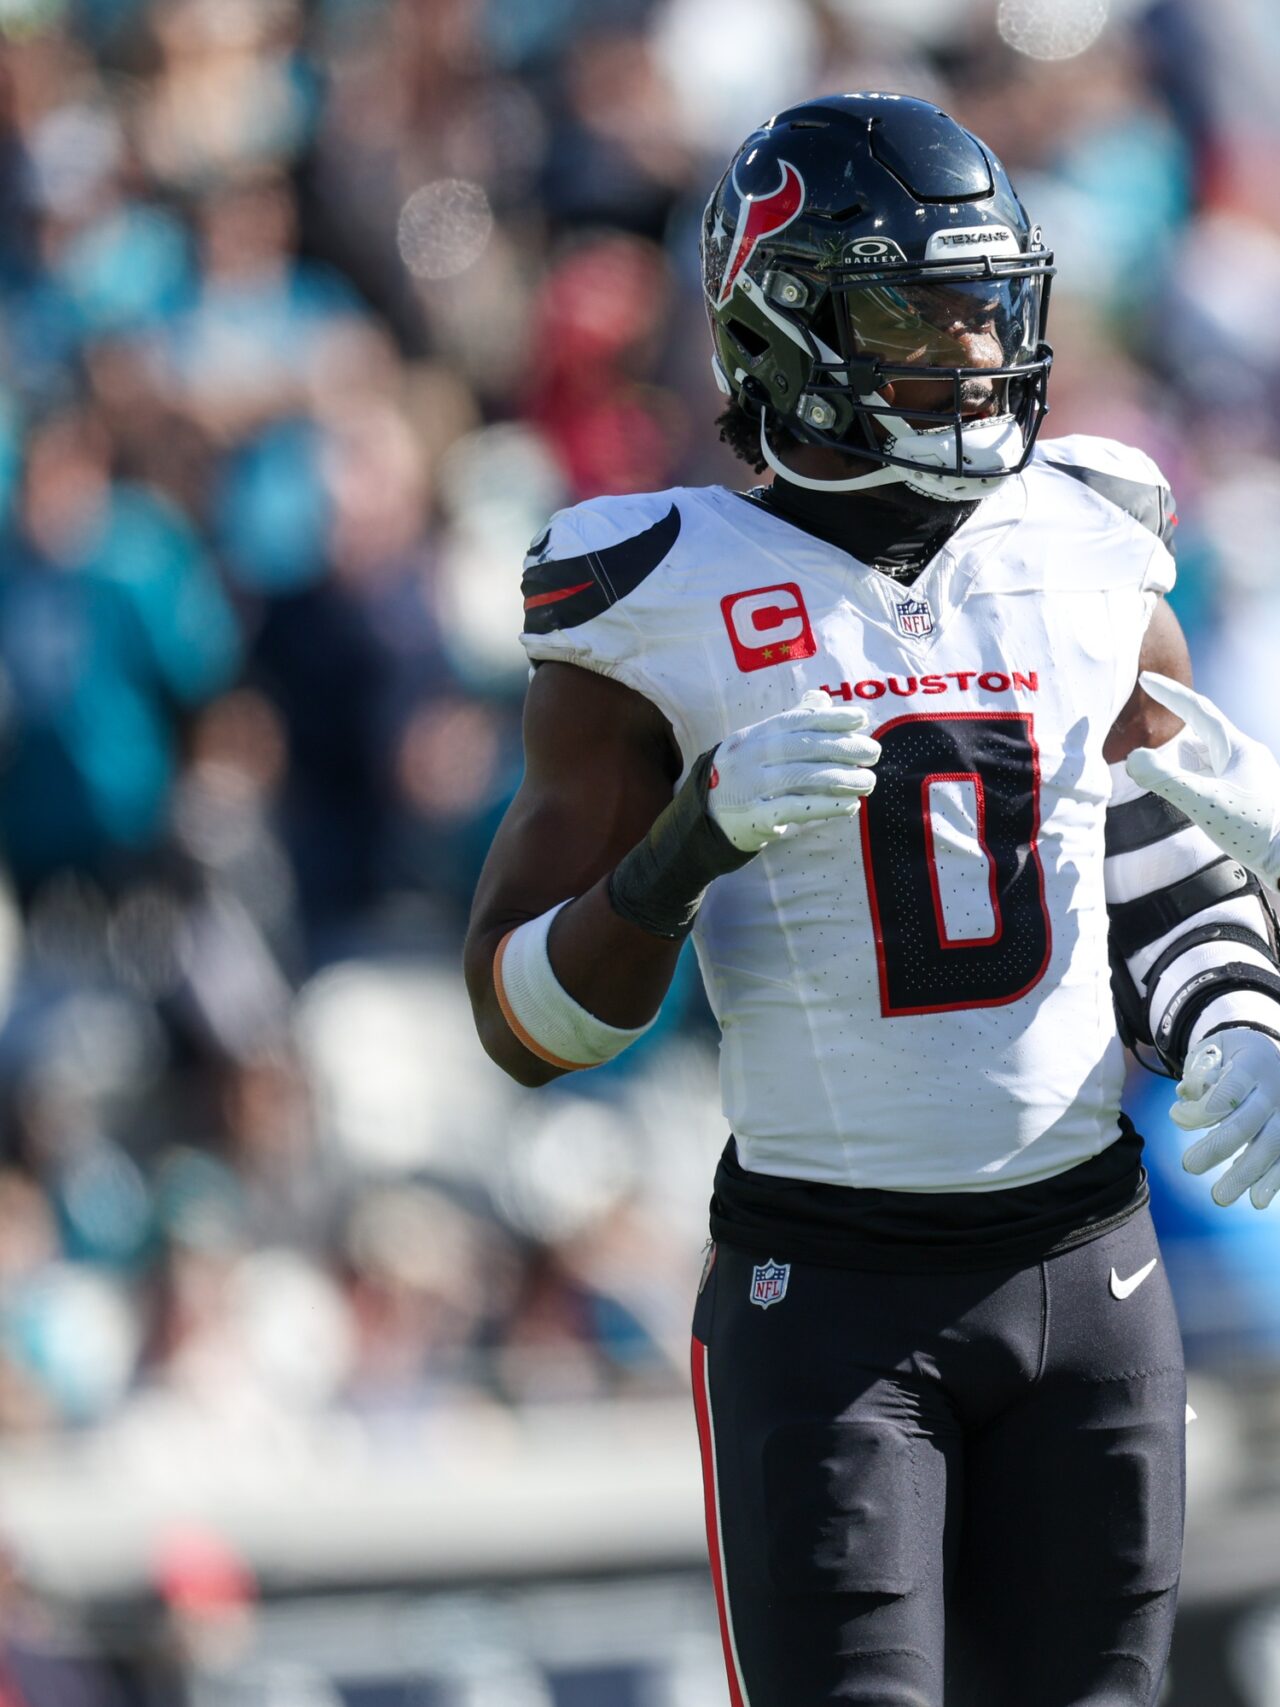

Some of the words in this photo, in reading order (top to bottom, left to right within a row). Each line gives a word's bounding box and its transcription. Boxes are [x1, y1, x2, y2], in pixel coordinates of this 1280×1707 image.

[938, 231, 1010, 245] TEXANS
[845, 255, 898, 264] OAKLEY
[730, 589, 804, 649] C
[902, 615, 930, 634] NFL
[819, 671, 1039, 701] HOUSTON
[859, 711, 1052, 1018] 0
[756, 1281, 780, 1298] NFL
